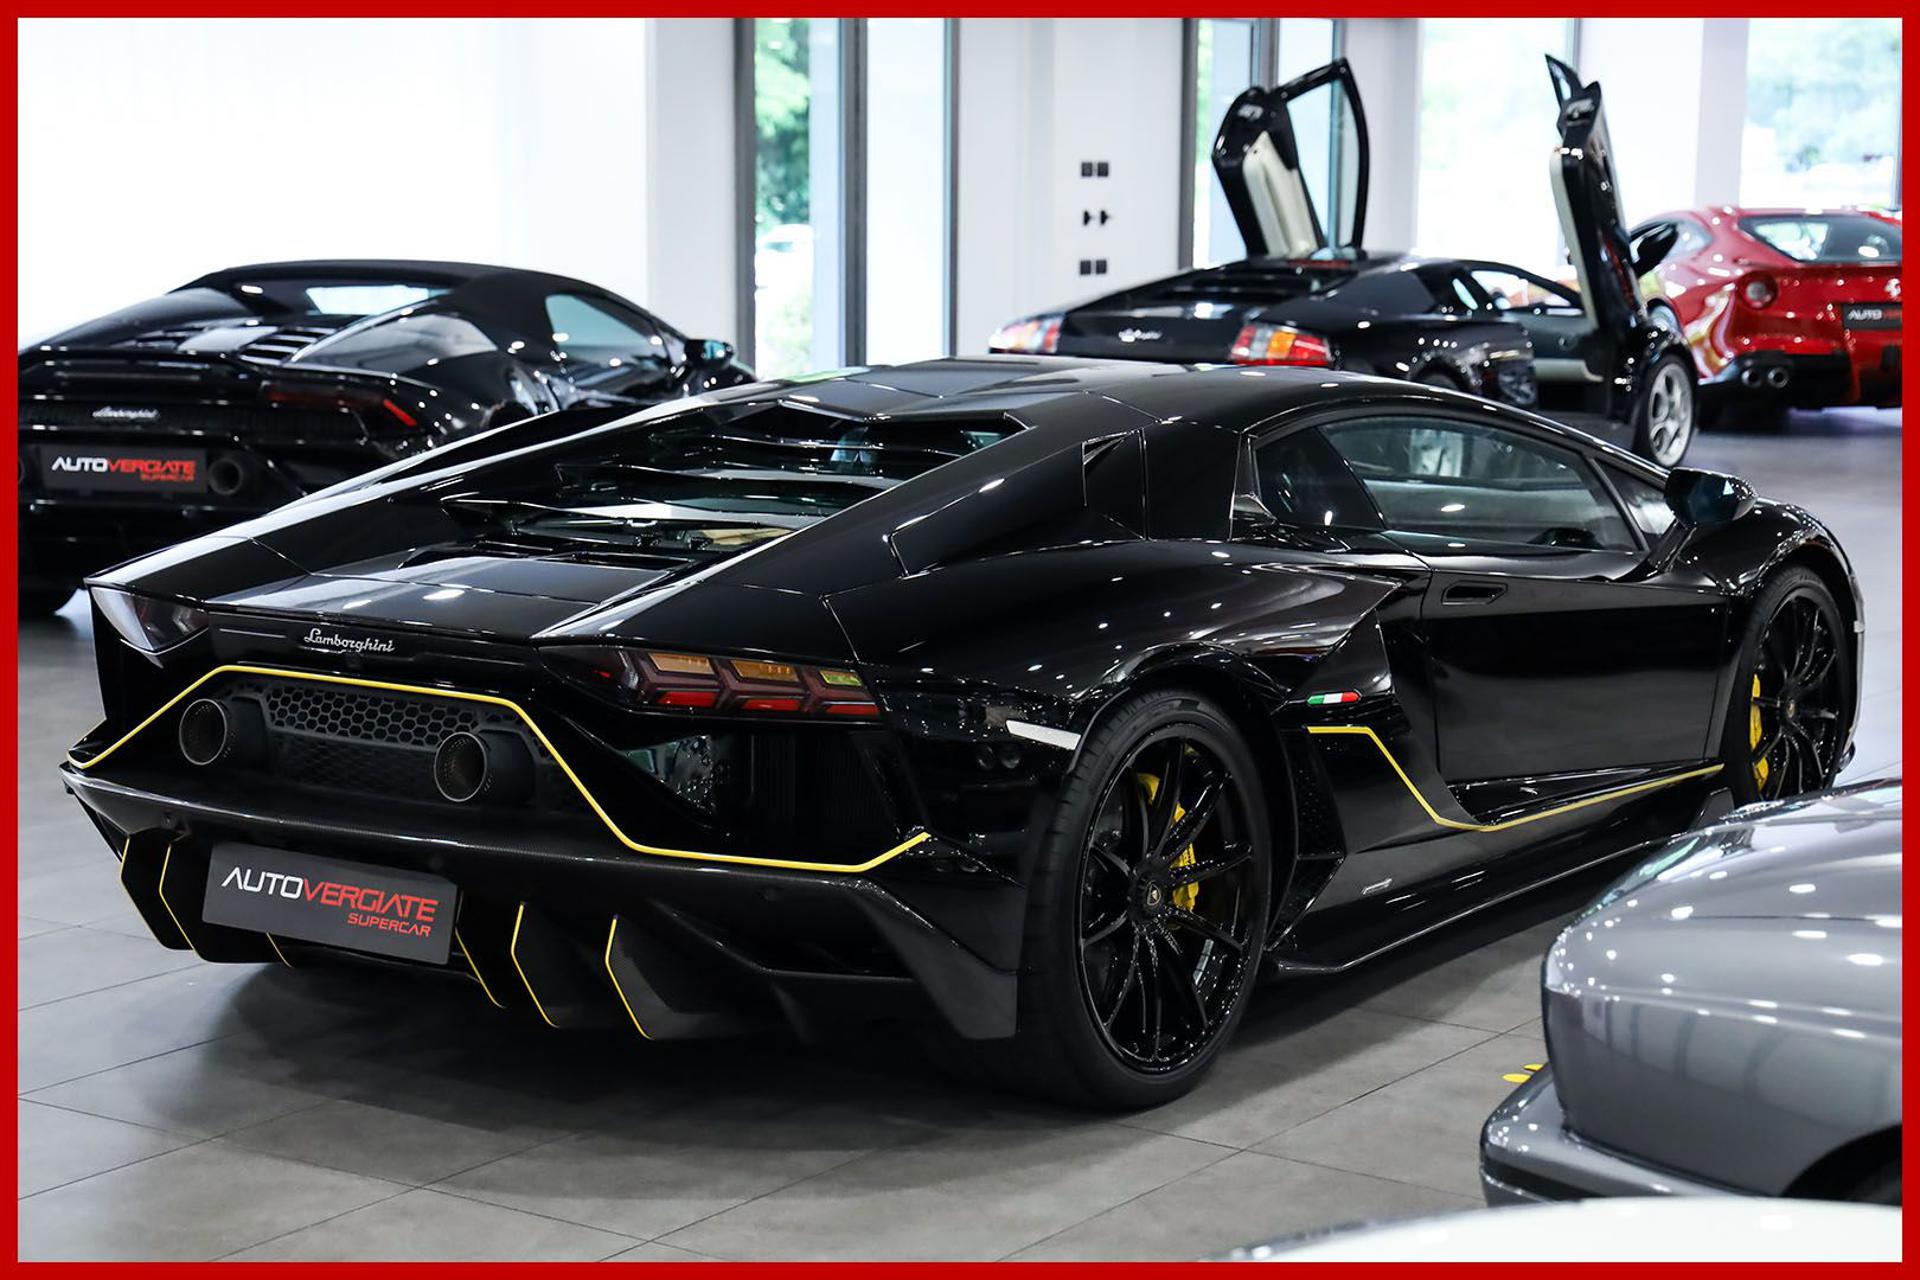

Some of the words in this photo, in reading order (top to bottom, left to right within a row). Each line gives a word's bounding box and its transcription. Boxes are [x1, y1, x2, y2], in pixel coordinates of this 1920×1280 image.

[52, 456, 196, 473] AUTOVERGIATE
[303, 627, 396, 653] Lamborghini
[220, 866, 439, 922] AUTOVERGIATE
[347, 912, 432, 937] SUPERCAR
